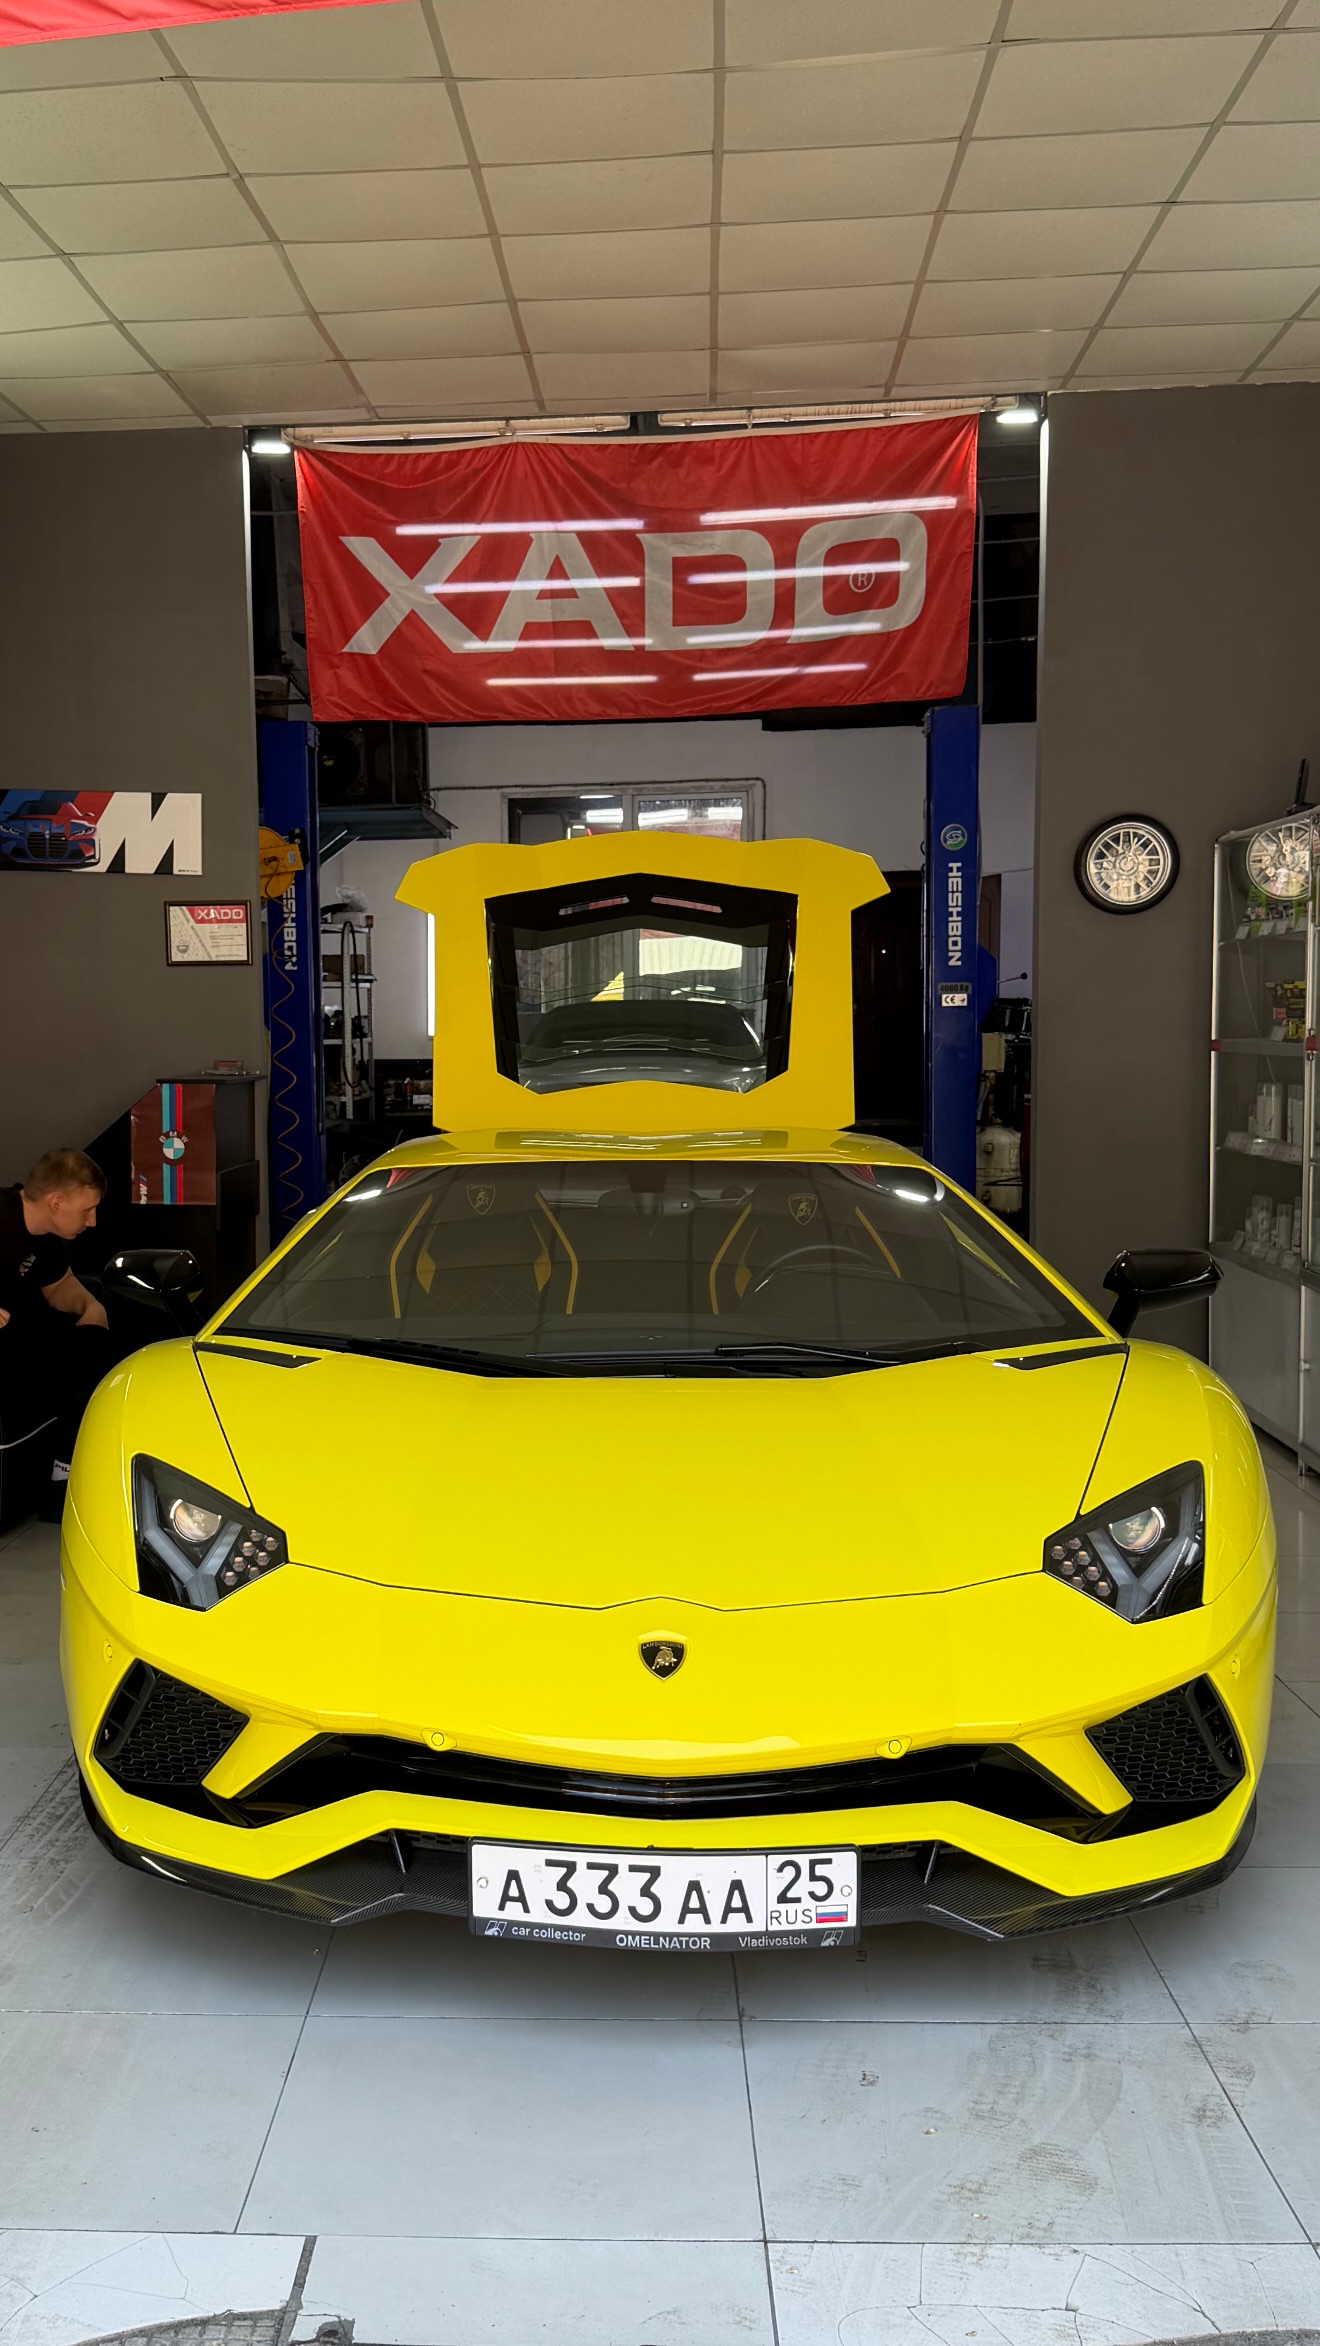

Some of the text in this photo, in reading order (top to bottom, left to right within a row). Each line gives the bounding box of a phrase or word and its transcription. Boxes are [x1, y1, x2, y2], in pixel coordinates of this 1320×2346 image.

[340, 511, 928, 655] XADO
[197, 908, 243, 920] XADO
[283, 879, 298, 970] ESHBON
[948, 862, 962, 966] HESHBON
[775, 1858, 835, 1905] 25
[511, 1926, 808, 1949] car collector OMELNATOR Vladivostok
[769, 1909, 813, 1926] RUS
